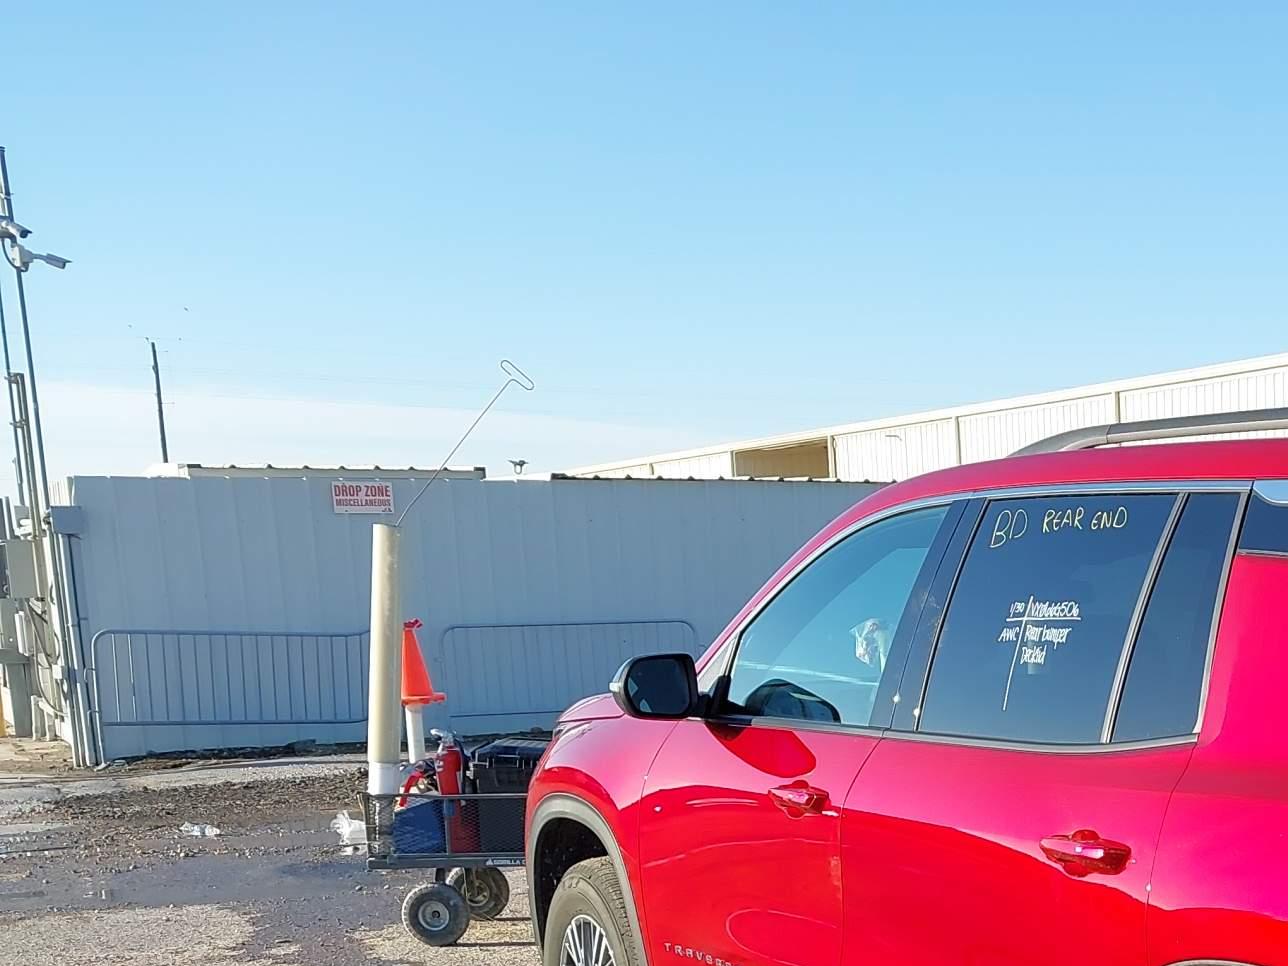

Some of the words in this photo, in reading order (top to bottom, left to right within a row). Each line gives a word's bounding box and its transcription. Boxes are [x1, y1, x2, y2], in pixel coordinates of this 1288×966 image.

[334, 485, 361, 497] DROP
[364, 485, 391, 497] ZONE
[335, 498, 391, 507] MISCELLANEOUS
[1043, 506, 1084, 533] REAR
[1091, 506, 1127, 530] END
